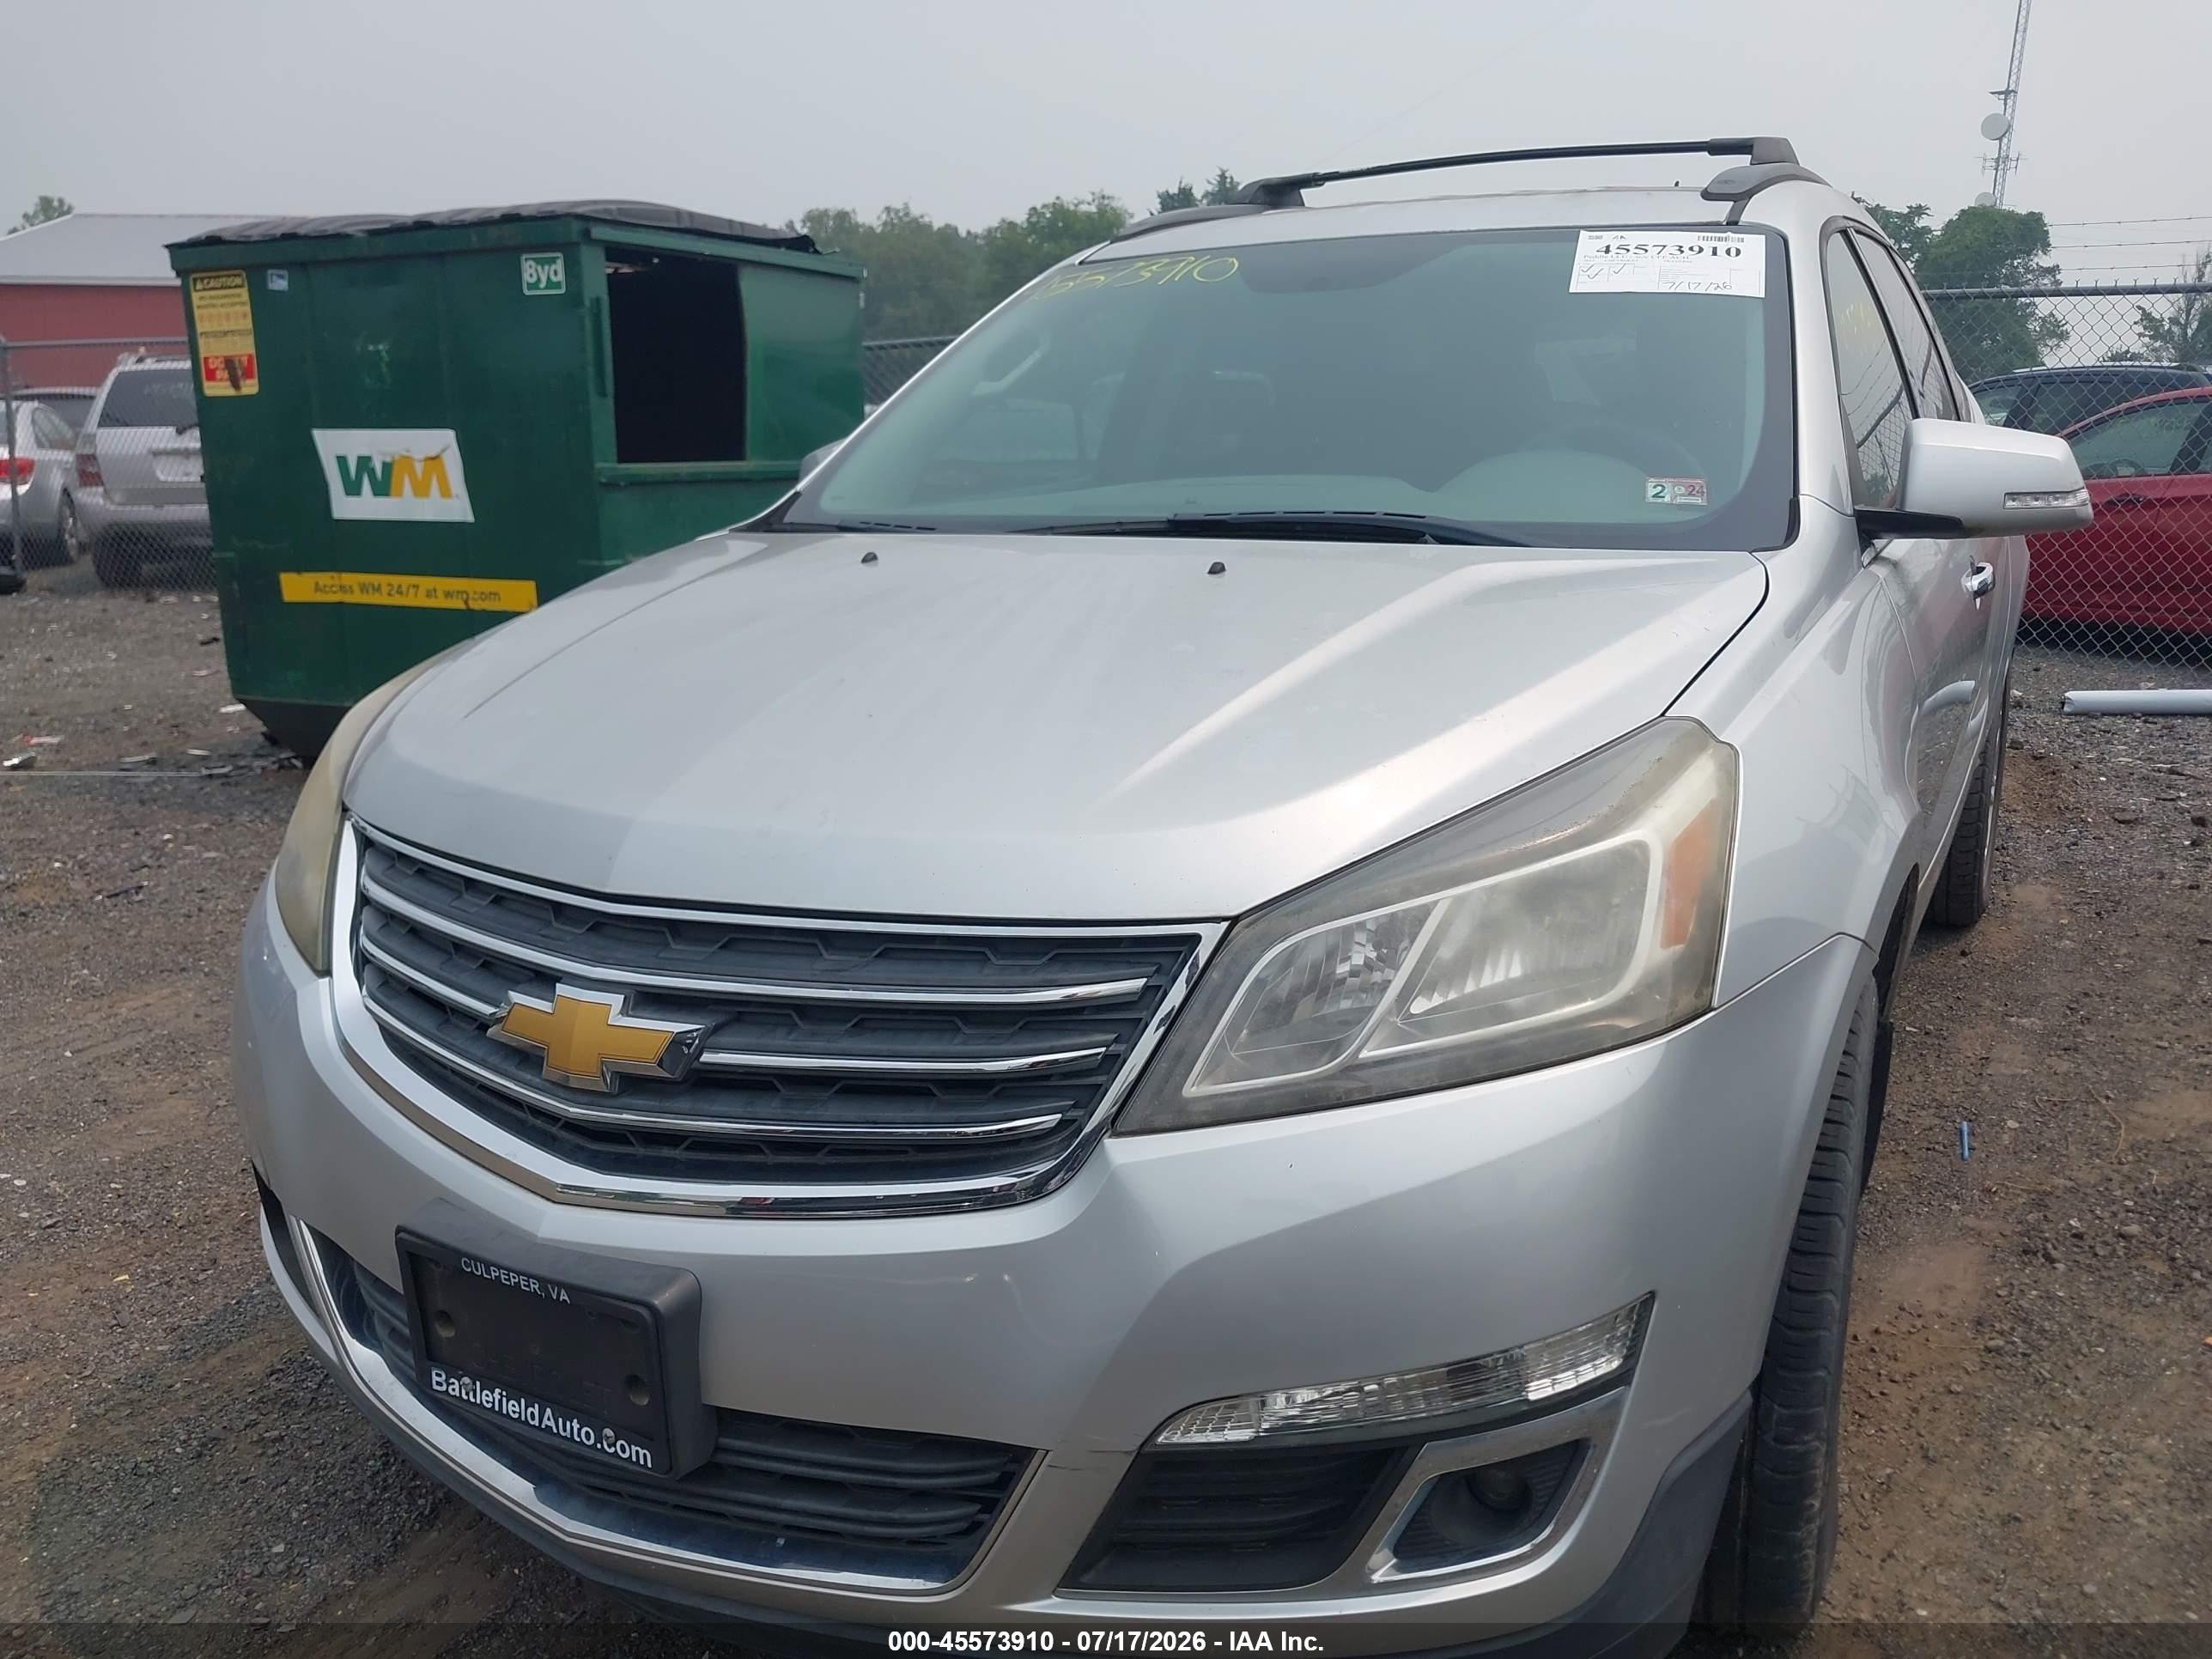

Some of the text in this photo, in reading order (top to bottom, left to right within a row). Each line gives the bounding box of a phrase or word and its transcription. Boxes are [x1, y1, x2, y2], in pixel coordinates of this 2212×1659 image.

[1595, 243, 1741, 258] 45573910
[336, 454, 453, 499] WM
[1651, 483, 1666, 499] 2
[314, 580, 354, 595] Access
[357, 581, 383, 596] WM
[386, 584, 420, 598] 24/7
[426, 587, 437, 599] at
[461, 1256, 571, 1304] CULPEPER, VA
